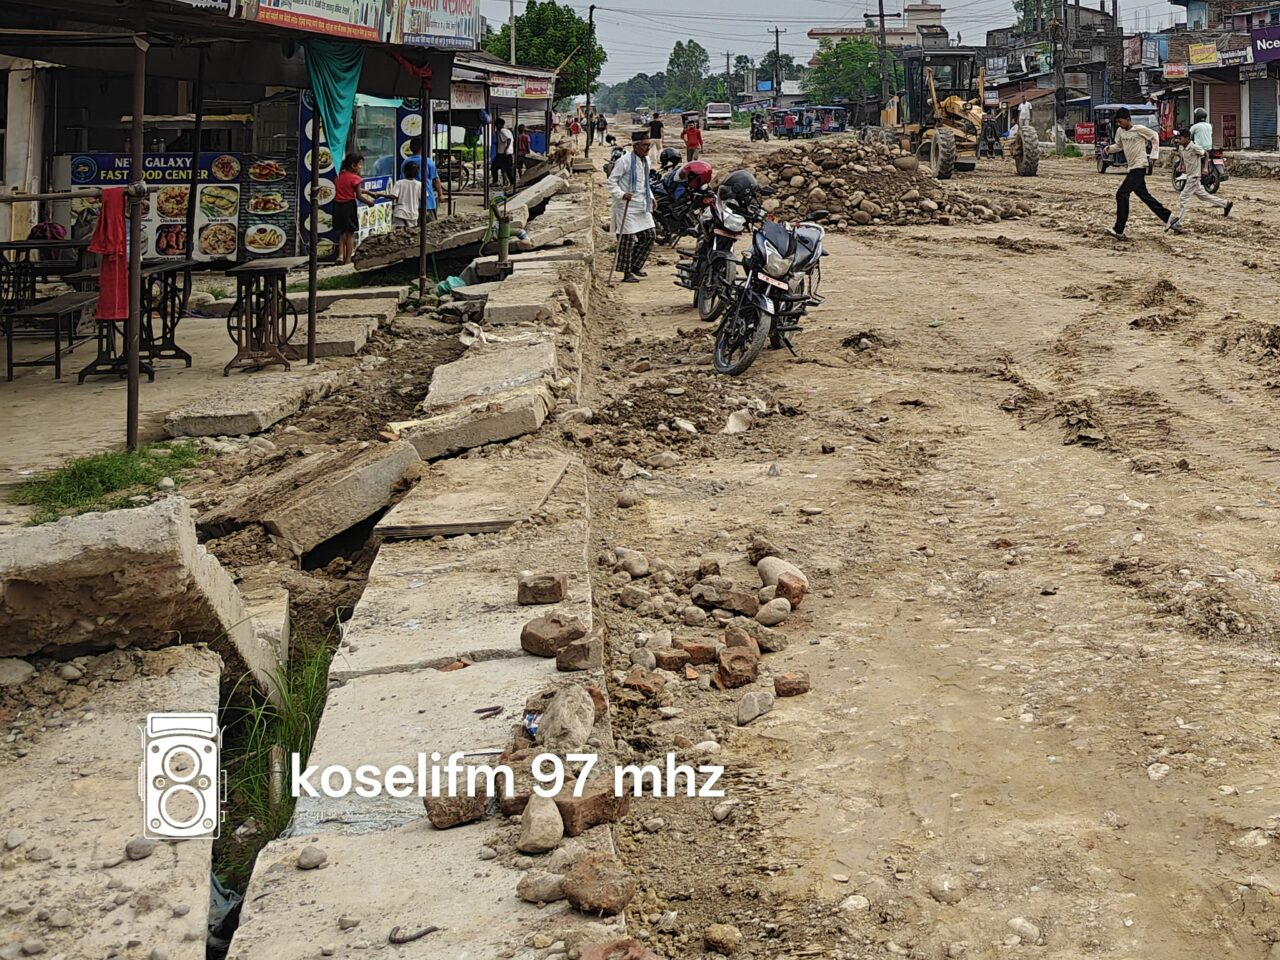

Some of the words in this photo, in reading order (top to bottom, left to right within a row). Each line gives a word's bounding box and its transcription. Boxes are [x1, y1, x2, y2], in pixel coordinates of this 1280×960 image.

[115, 158, 133, 167] NE
[145, 157, 193, 168] GALAXY
[100, 170, 129, 180] FAST
[165, 170, 208, 180] CENTR
